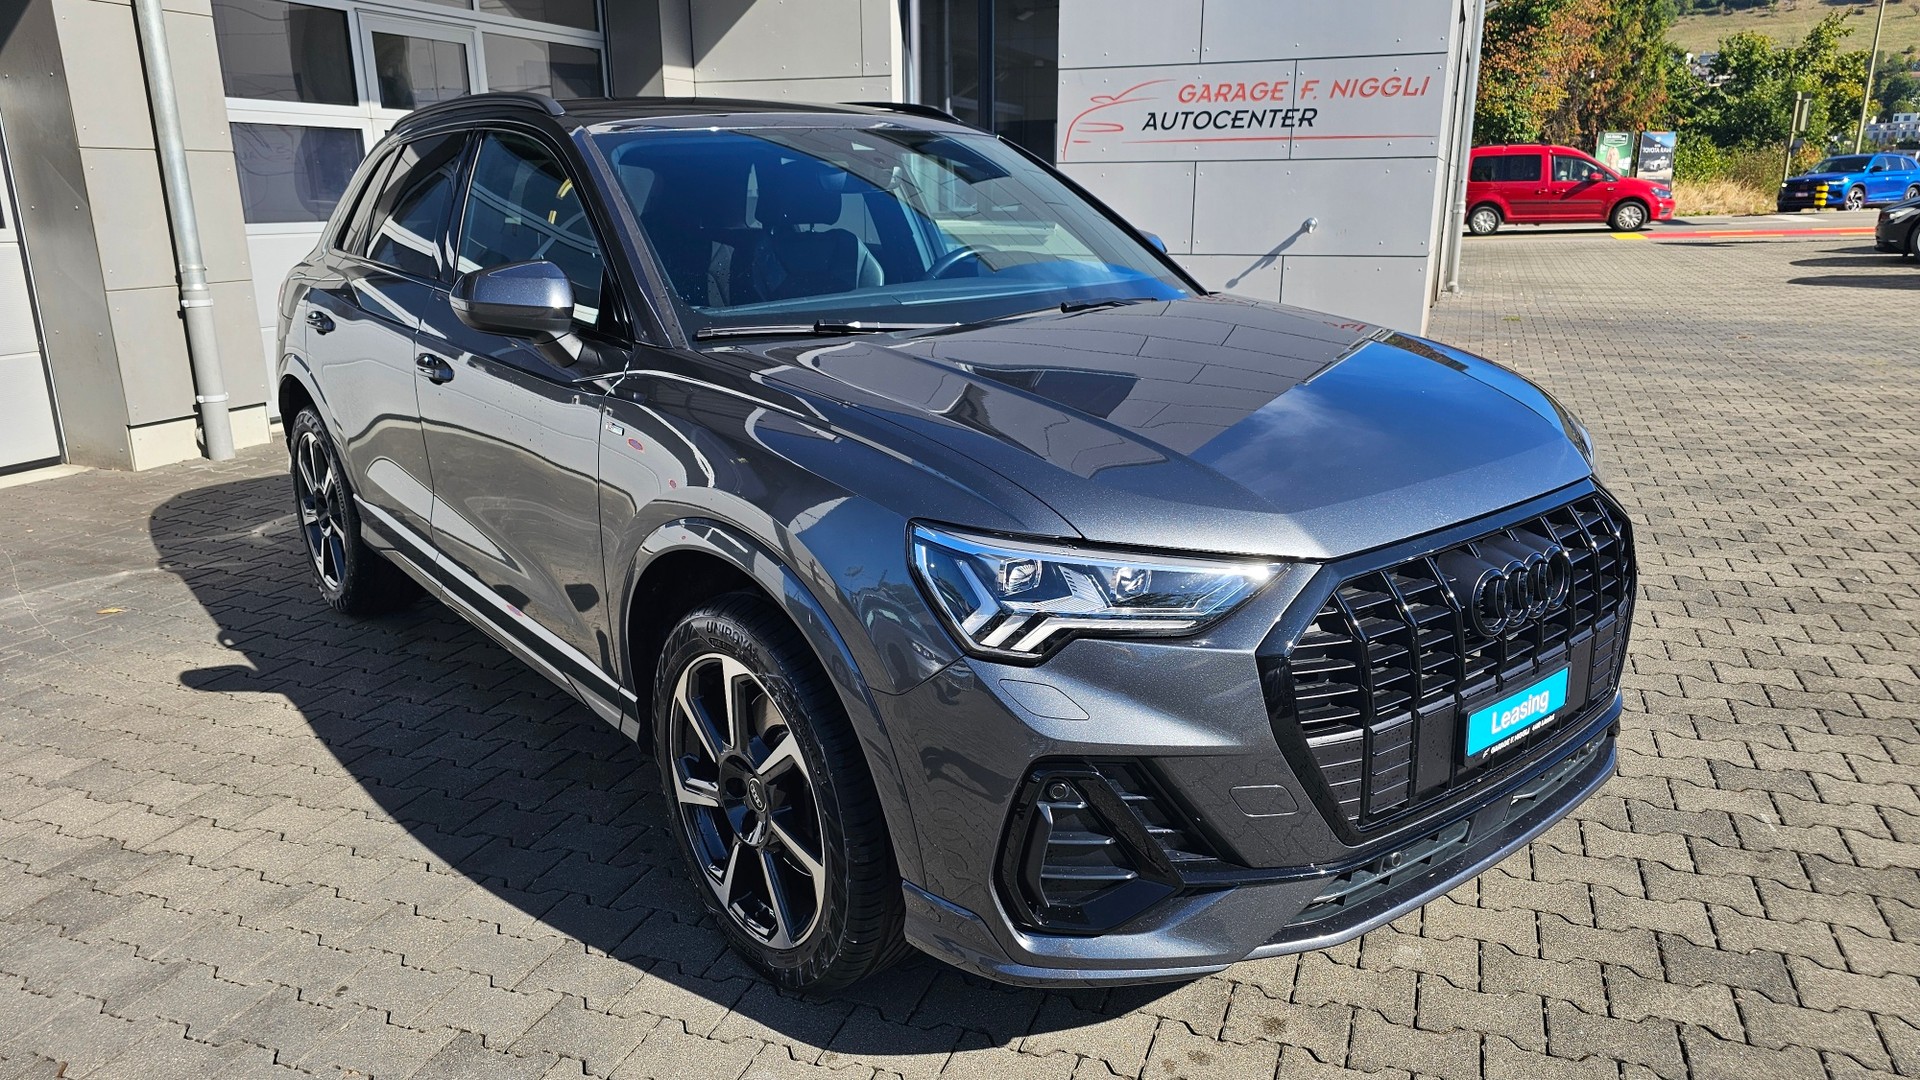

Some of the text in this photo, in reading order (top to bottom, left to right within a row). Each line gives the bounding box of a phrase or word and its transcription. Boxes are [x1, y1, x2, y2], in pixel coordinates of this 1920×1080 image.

[1177, 76, 1431, 104] GARAGE F. NIGGLI
[1141, 108, 1319, 131] AUTOCENTER
[1491, 690, 1550, 735] Leasing
